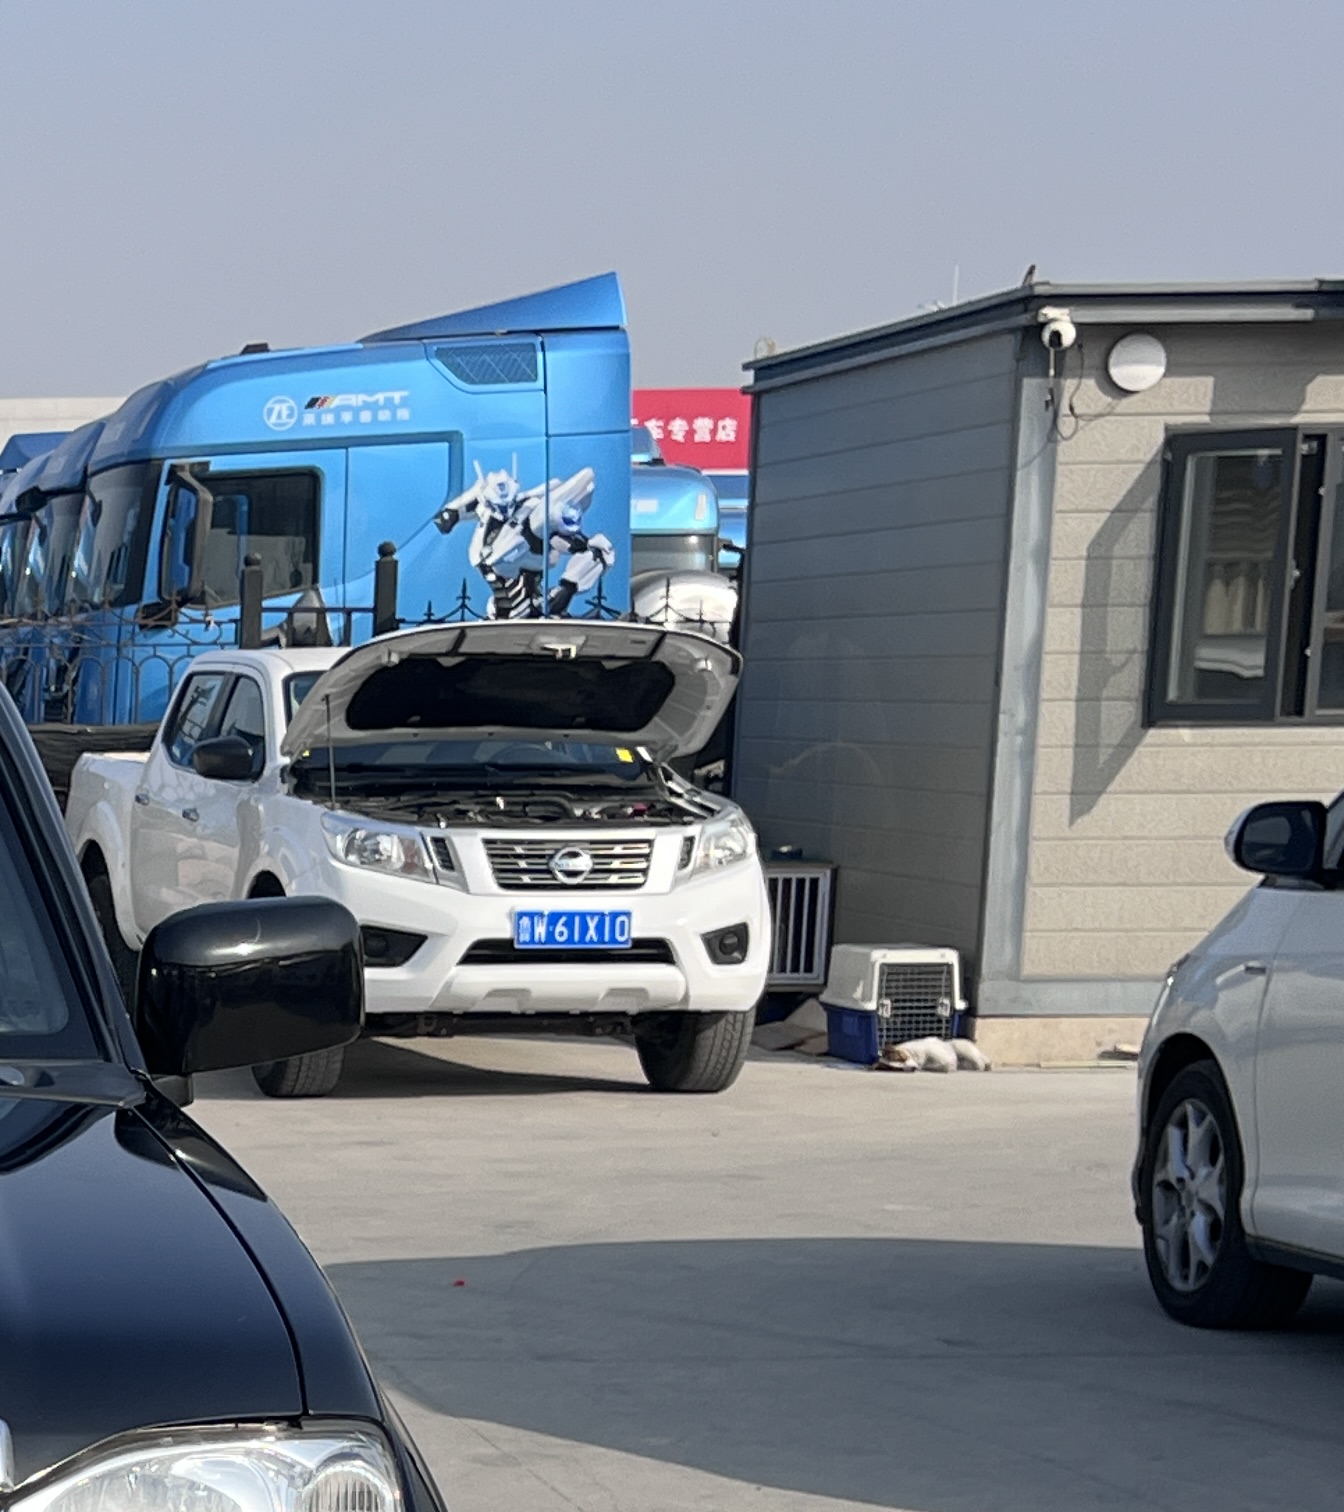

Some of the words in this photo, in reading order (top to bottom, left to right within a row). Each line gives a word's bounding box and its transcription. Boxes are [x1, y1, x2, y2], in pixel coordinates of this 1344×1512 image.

[330, 390, 410, 409] AMT
[630, 416, 738, 443] 车专营店
